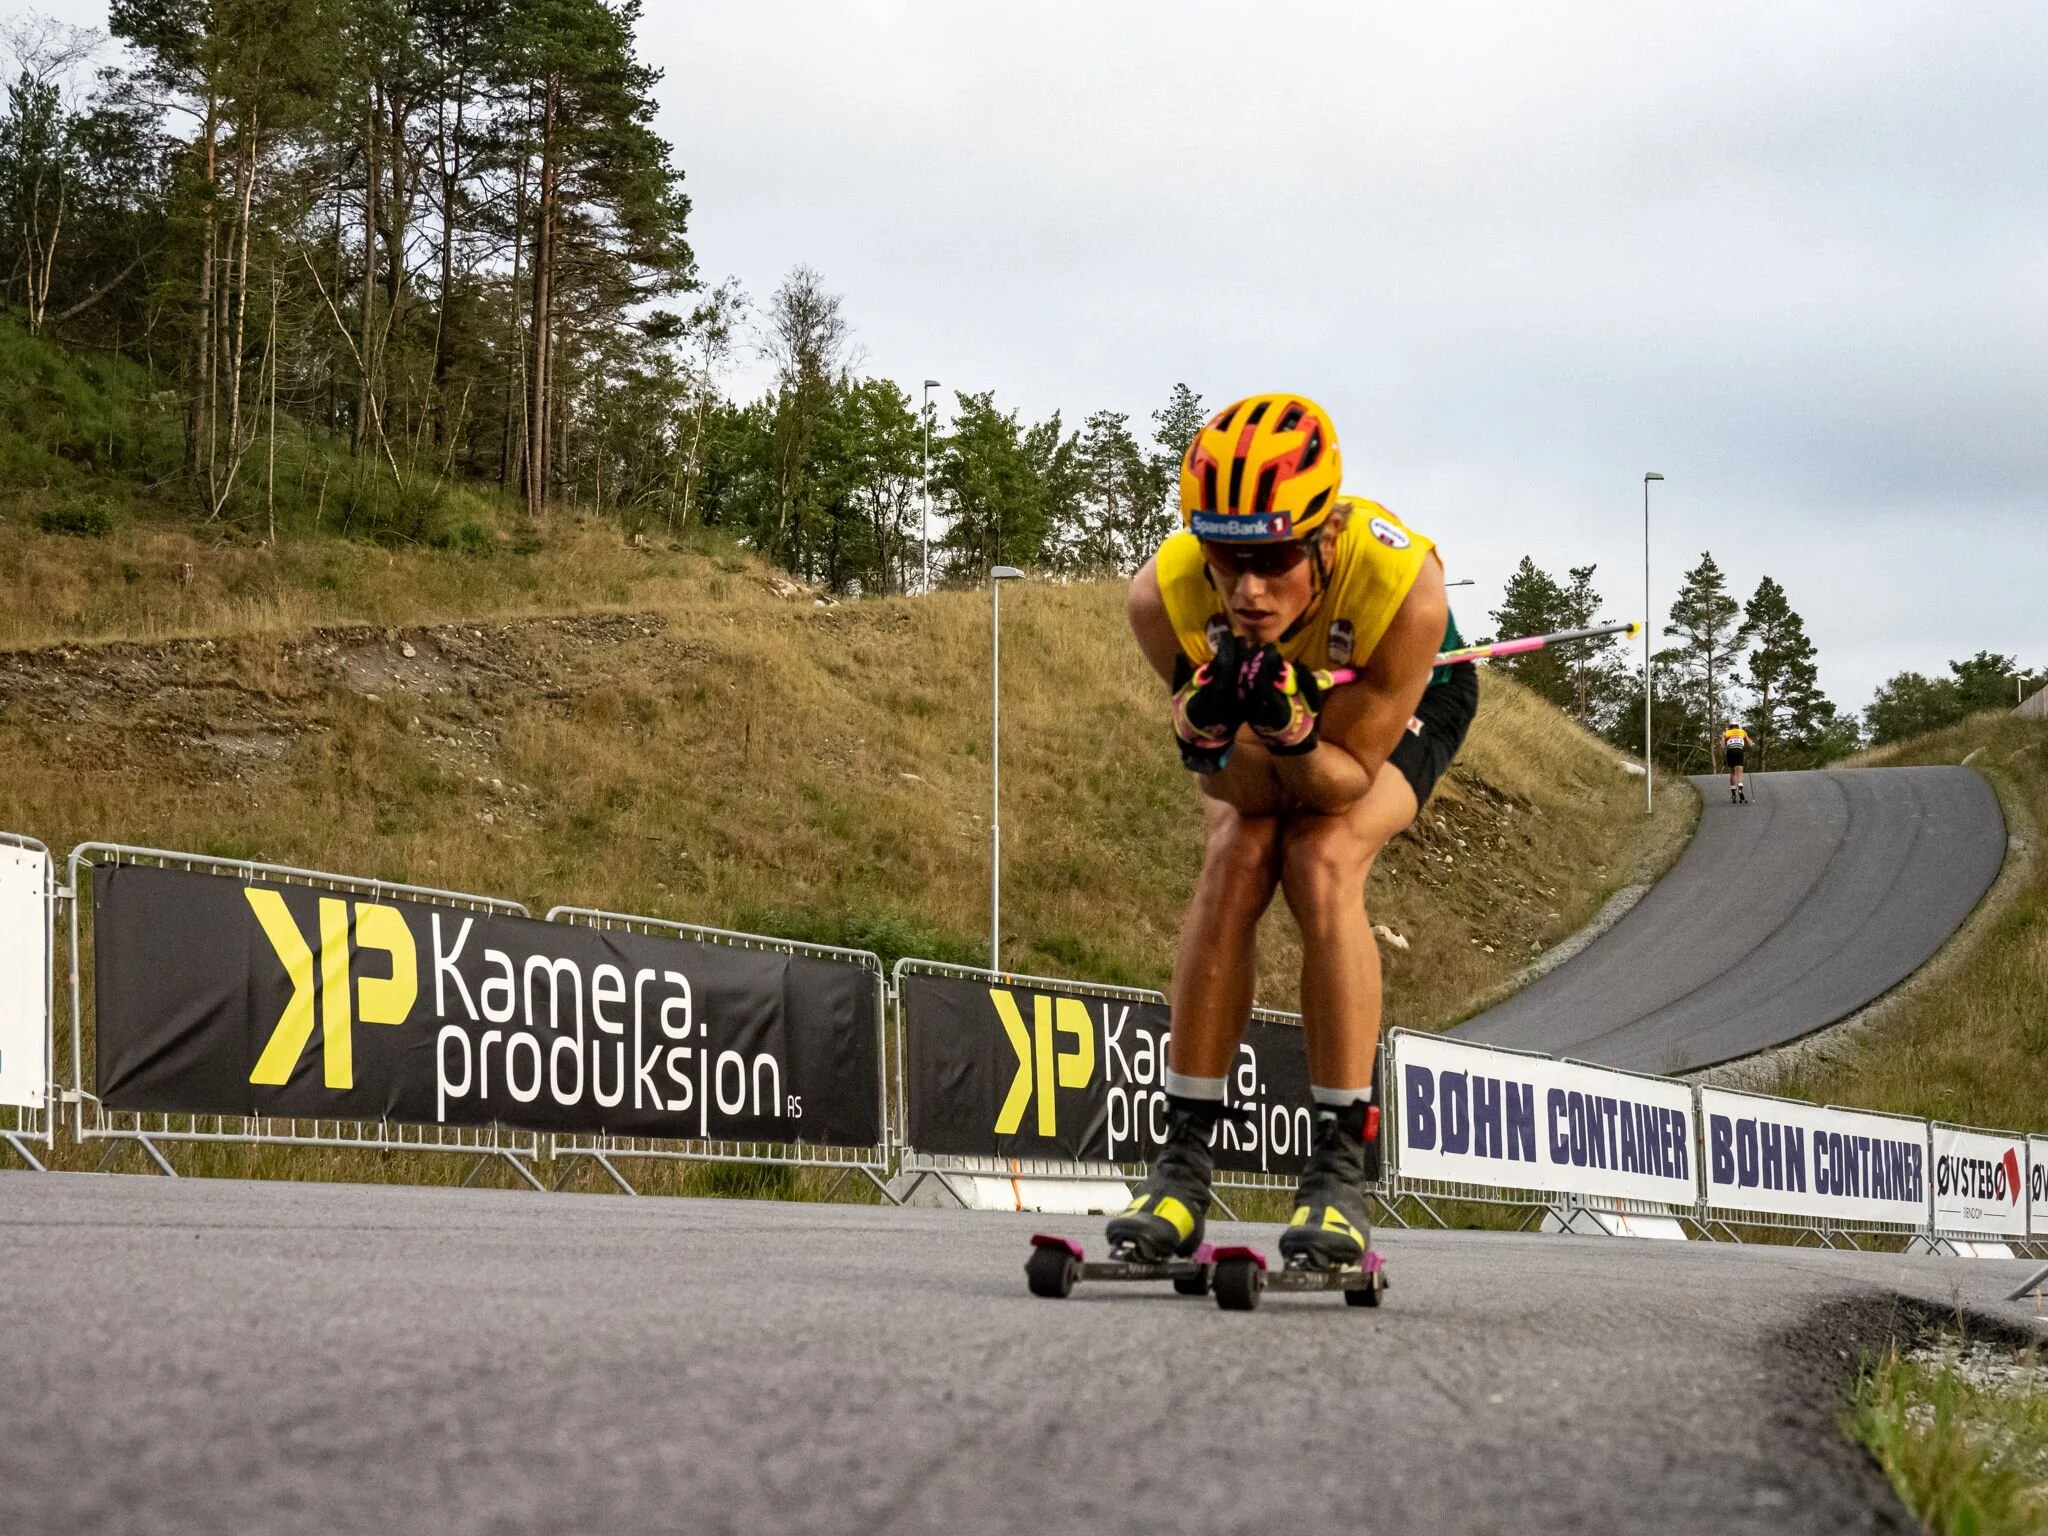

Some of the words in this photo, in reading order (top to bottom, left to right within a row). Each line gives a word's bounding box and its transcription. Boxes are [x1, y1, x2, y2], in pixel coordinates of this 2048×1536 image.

[1192, 515, 1268, 535] SpareBank
[1273, 517, 1284, 532] 1
[432, 912, 692, 1041] Kamera
[436, 1022, 782, 1137] produksjon
[787, 1094, 803, 1119] AS
[1405, 1063, 1537, 1163] BØHN
[1547, 1087, 1689, 1181] CONTAINER
[1710, 1113, 1807, 1193] BØHN
[1813, 1130, 1923, 1203] CONTAINER
[1937, 1153, 2007, 1201] ØVSTEBØ
